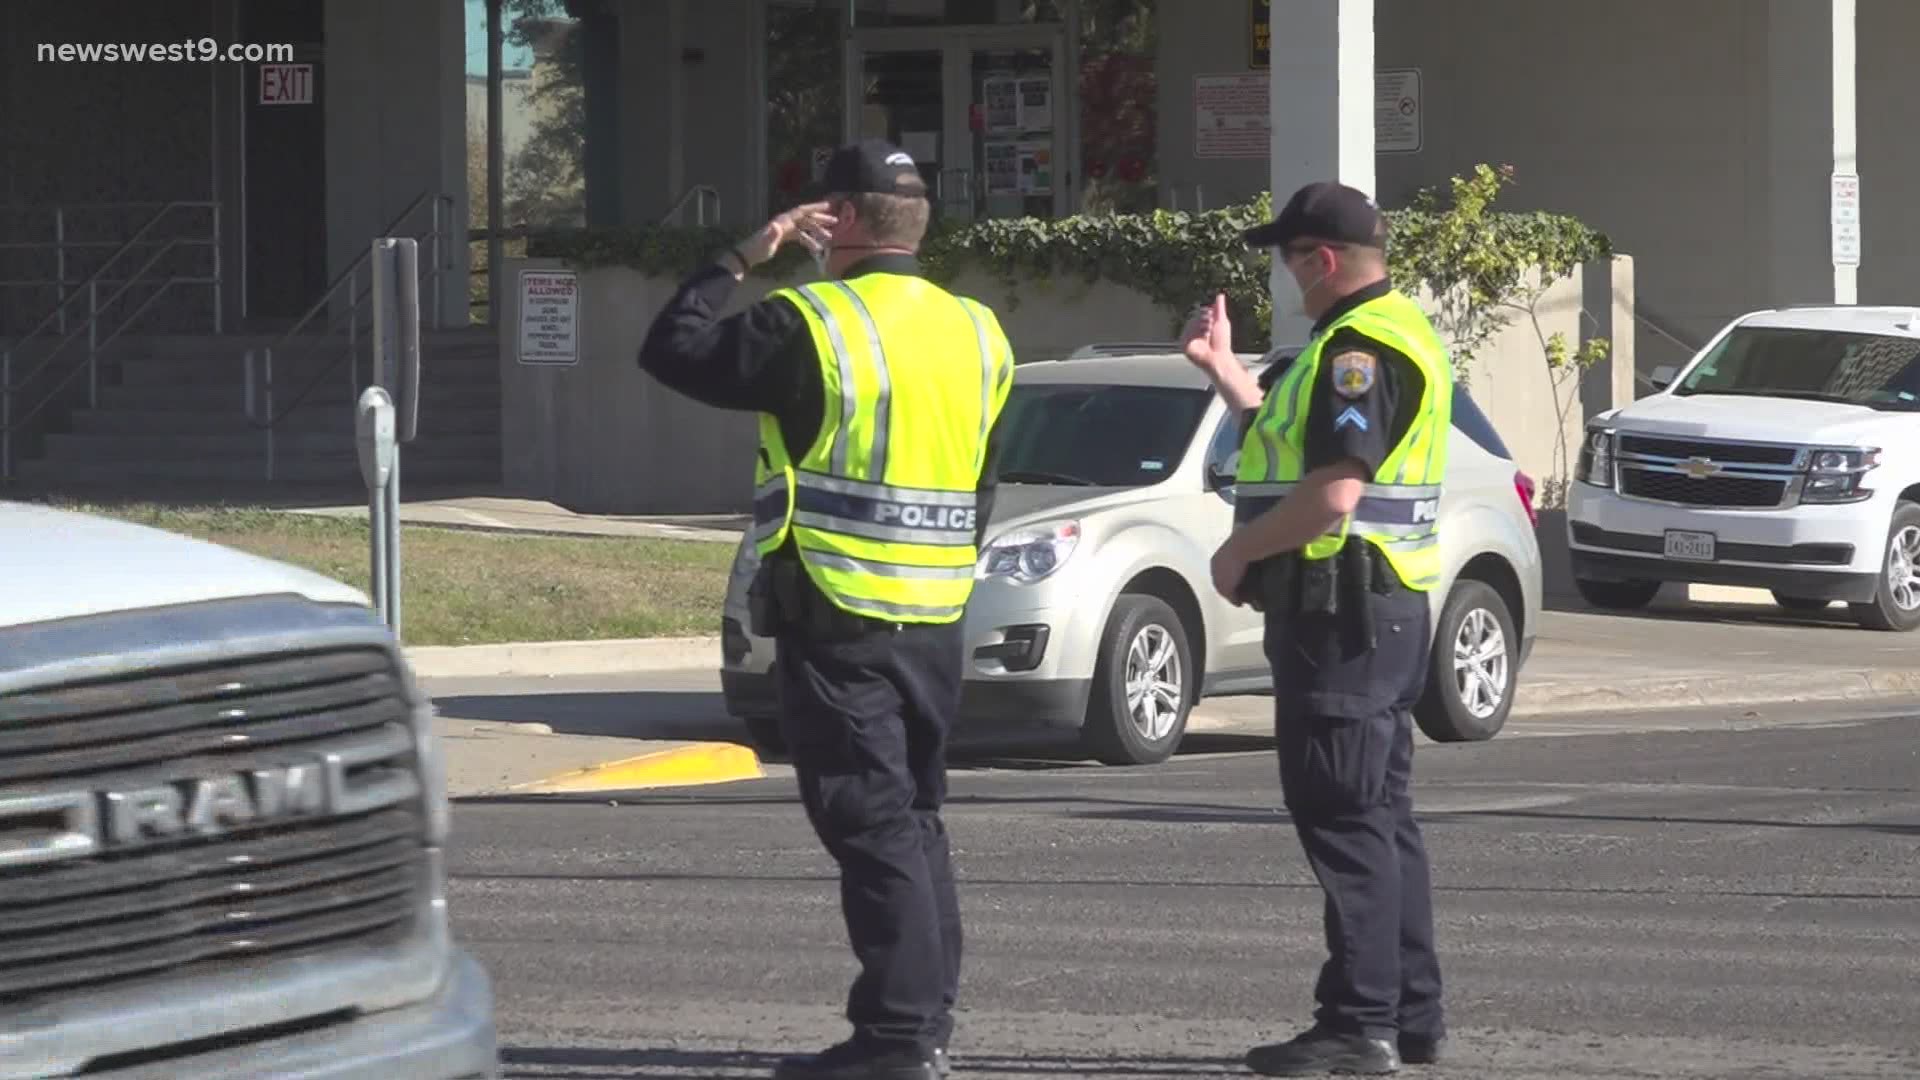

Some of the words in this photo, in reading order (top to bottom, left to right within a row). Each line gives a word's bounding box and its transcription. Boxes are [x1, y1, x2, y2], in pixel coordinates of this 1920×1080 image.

[263, 67, 310, 101] EXIT
[875, 503, 977, 529] POLICE
[106, 763, 322, 843] RAM
